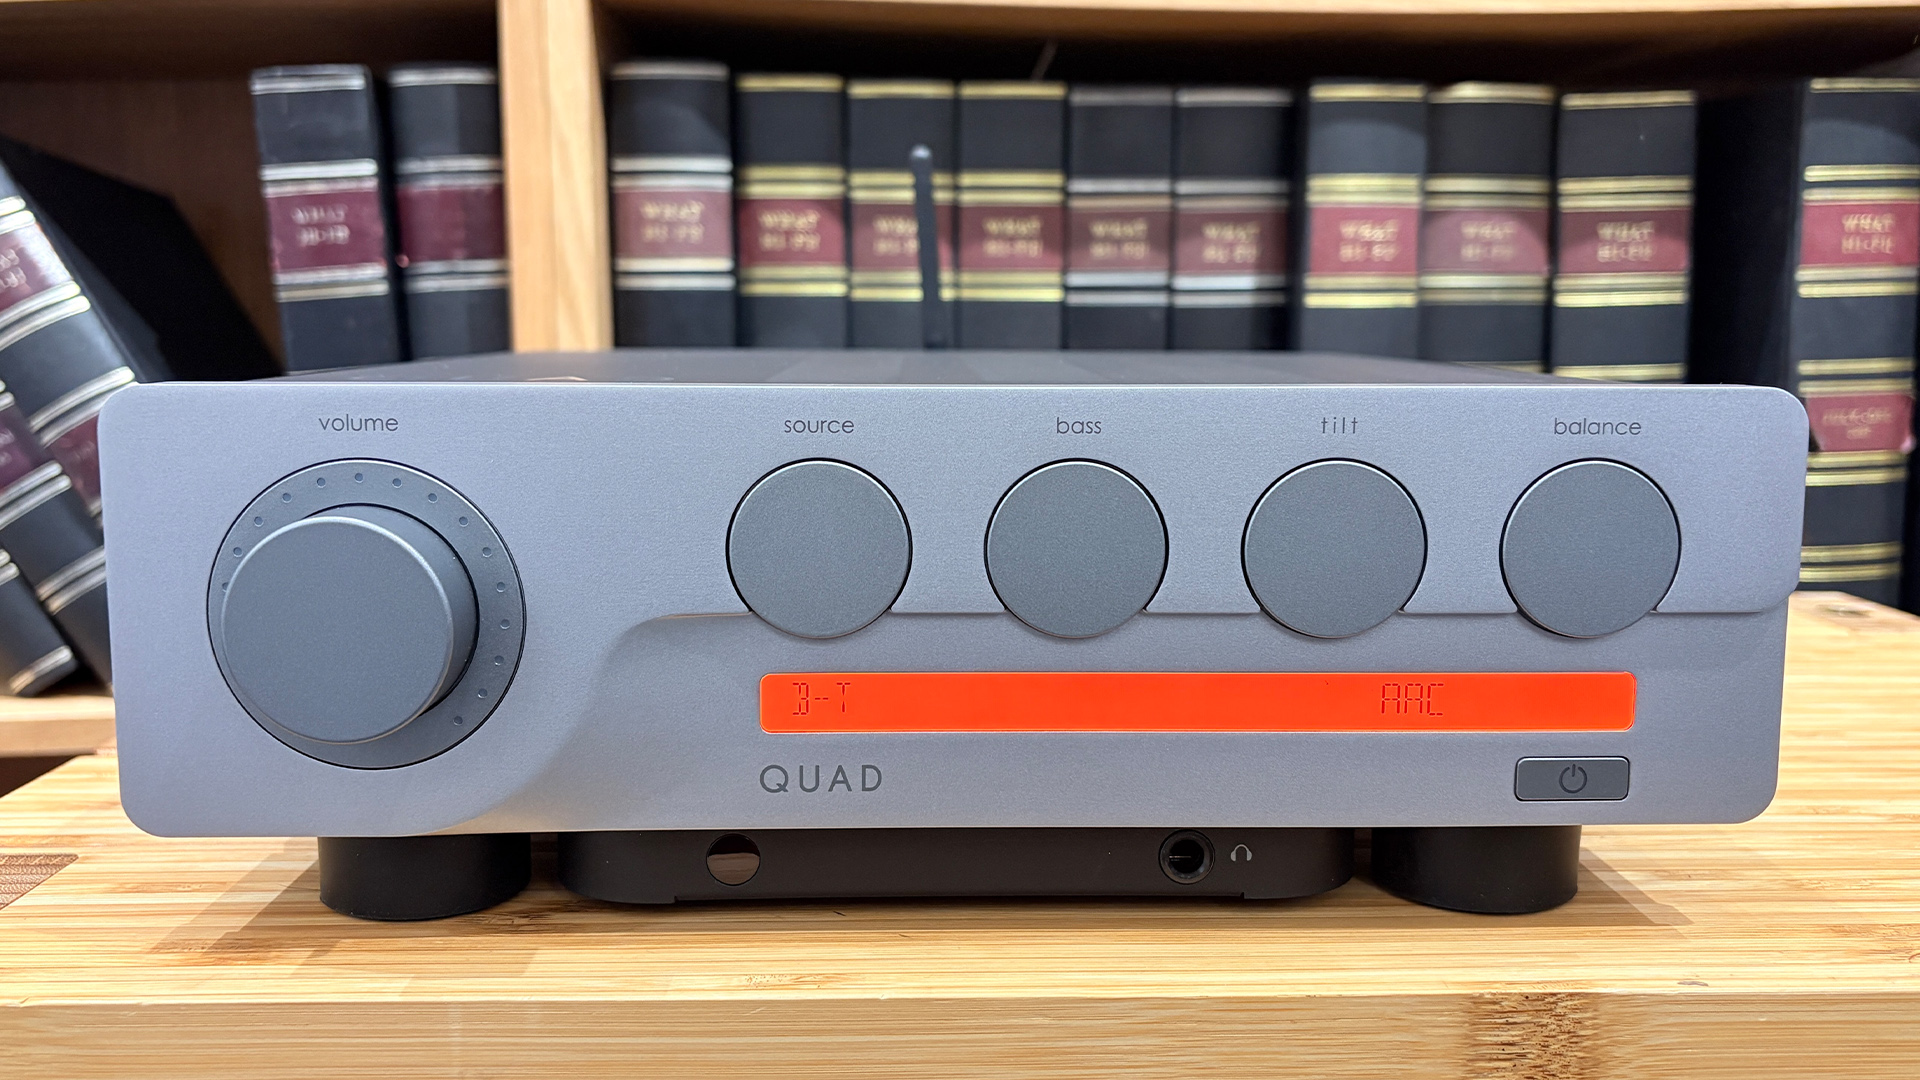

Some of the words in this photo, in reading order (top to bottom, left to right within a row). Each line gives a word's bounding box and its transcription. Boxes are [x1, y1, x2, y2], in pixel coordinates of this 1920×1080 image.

[318, 413, 399, 432] volume
[784, 419, 855, 434] source
[1056, 417, 1102, 434] bass
[1321, 416, 1358, 434] tilt
[1553, 417, 1642, 436] balance
[1381, 682, 1444, 717] AAC
[759, 764, 883, 793] QUAD
